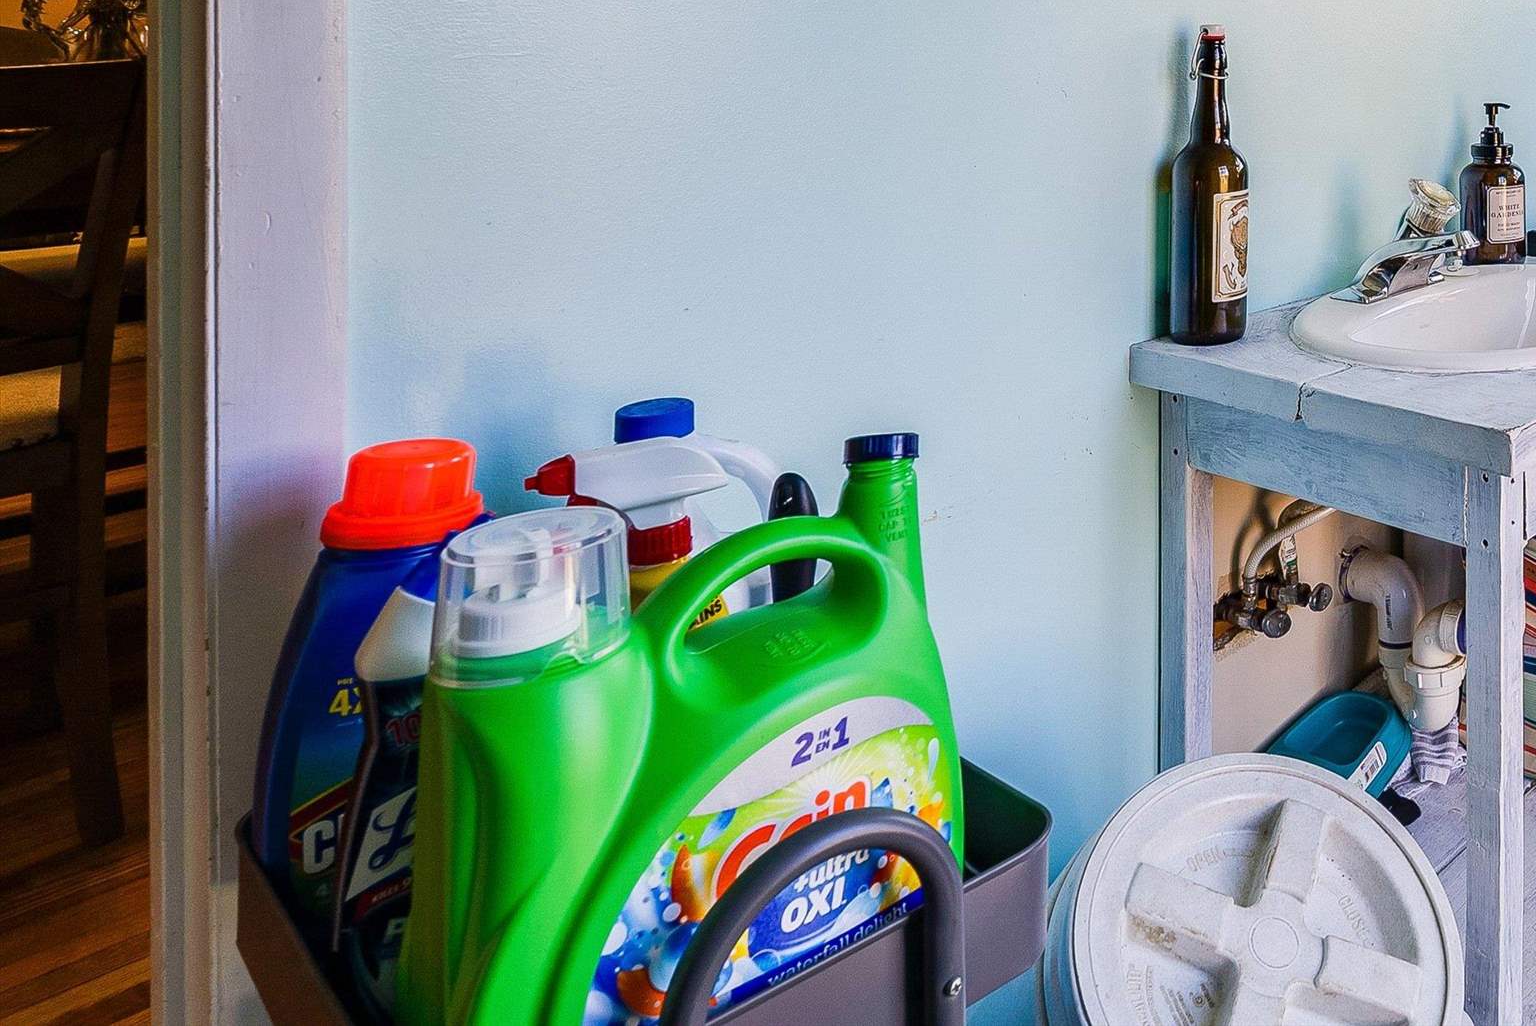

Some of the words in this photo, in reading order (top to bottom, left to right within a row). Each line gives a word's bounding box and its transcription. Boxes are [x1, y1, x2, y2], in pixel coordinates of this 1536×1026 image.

[791, 731, 814, 767] 2
[818, 727, 831, 740] IN
[832, 716, 850, 751] 1
